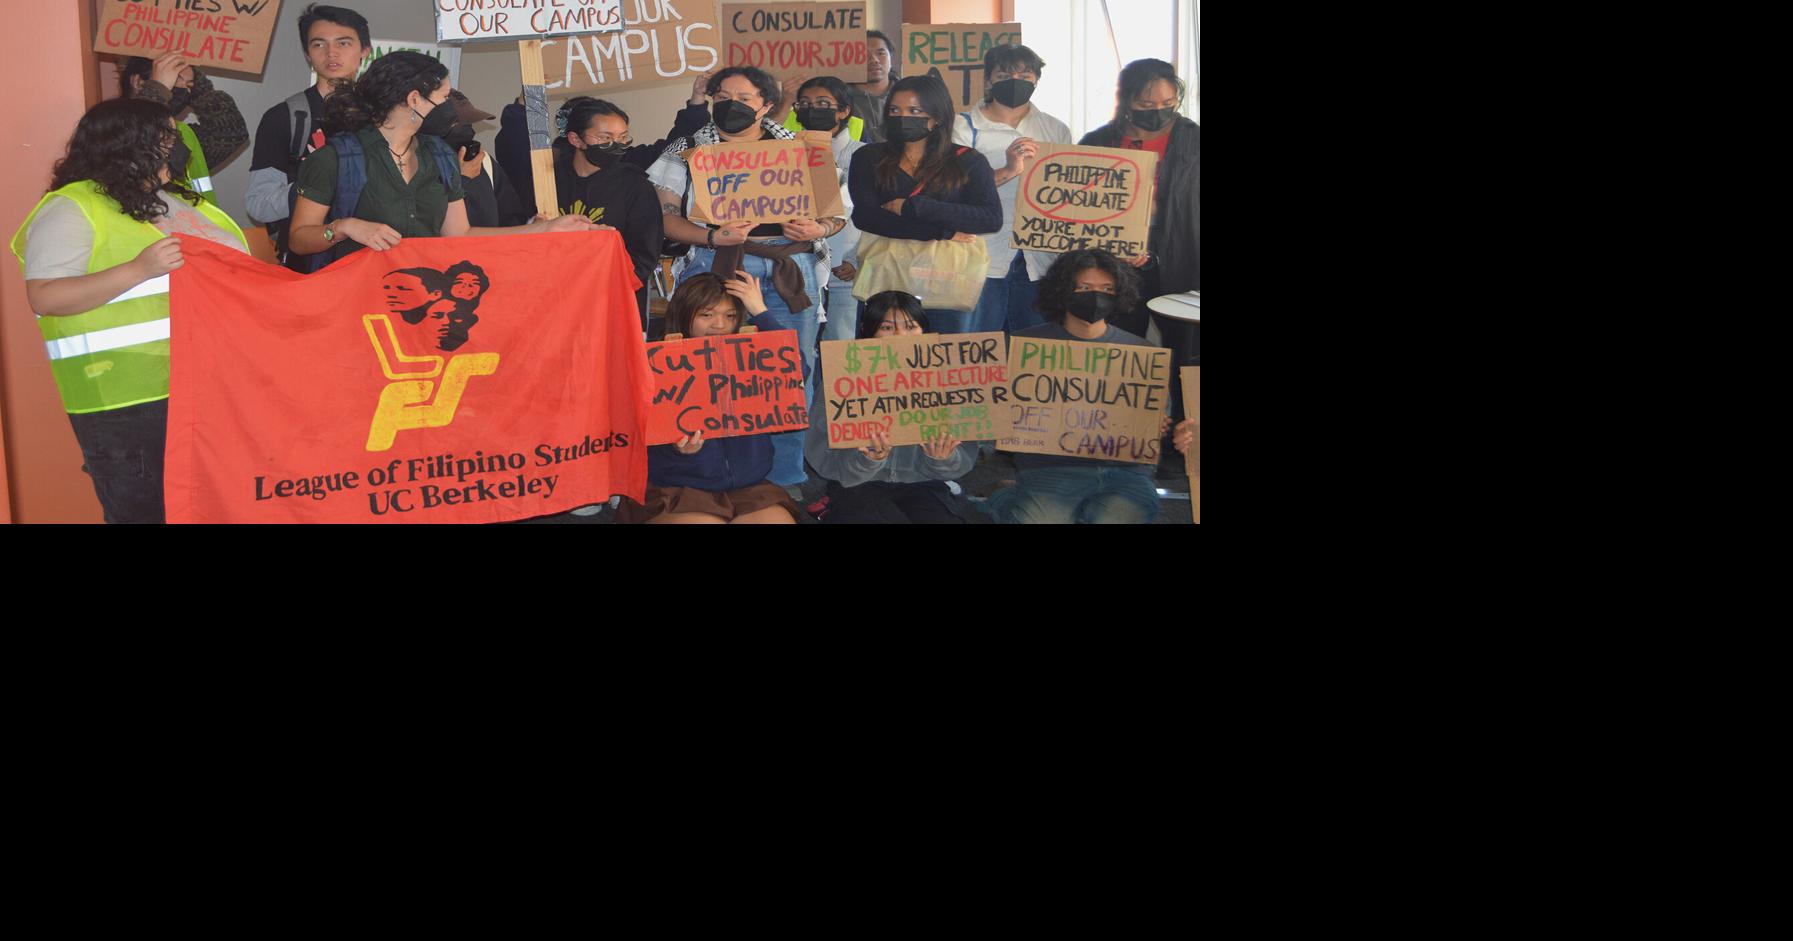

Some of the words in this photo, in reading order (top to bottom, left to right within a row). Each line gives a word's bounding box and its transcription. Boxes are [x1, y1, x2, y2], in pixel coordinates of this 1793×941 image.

[123, 3, 237, 34] PHILIPPINE
[459, 12, 509, 36] OUR
[531, 6, 621, 33] CAMPUS
[732, 8, 863, 34] CONSULATE
[104, 18, 250, 63] CONSULATE
[693, 147, 827, 172] CONSULATE
[706, 172, 751, 196] OFF
[759, 168, 804, 187] OUR
[1044, 162, 1131, 190] PHILIPPINE
[711, 195, 810, 221] CAMPUS!!
[1036, 186, 1130, 211] CONSULATE
[1012, 231, 1092, 251] WELCOME
[1097, 239, 1144, 256] HERE!
[1081, 223, 1125, 238] NOT
[646, 340, 717, 374] Cut
[725, 338, 797, 373] Ties
[906, 343, 953, 369] JUST
[959, 338, 999, 365] FOR
[1020, 342, 1168, 381] PHILIPPINE
[708, 373, 804, 405] Philippine
[834, 373, 889, 398] ONE
[894, 370, 933, 391] ART
[937, 365, 1008, 388] LECTURE
[1011, 373, 1166, 410] CONSULATE
[829, 397, 869, 421] YET
[872, 393, 908, 415] ATN
[911, 388, 985, 409] REQUESTS
[992, 386, 1008, 404] R
[1064, 406, 1108, 431] OUR
[676, 402, 809, 437] Consulate
[830, 415, 893, 443] DENIED?
[899, 409, 927, 426] DO
[1058, 431, 1161, 460] CAMPUS
[254, 471, 360, 501] League
[367, 459, 402, 486] of
[407, 450, 526, 482] Filipino
[367, 489, 414, 516] UC
[420, 474, 559, 509] Berkeley
